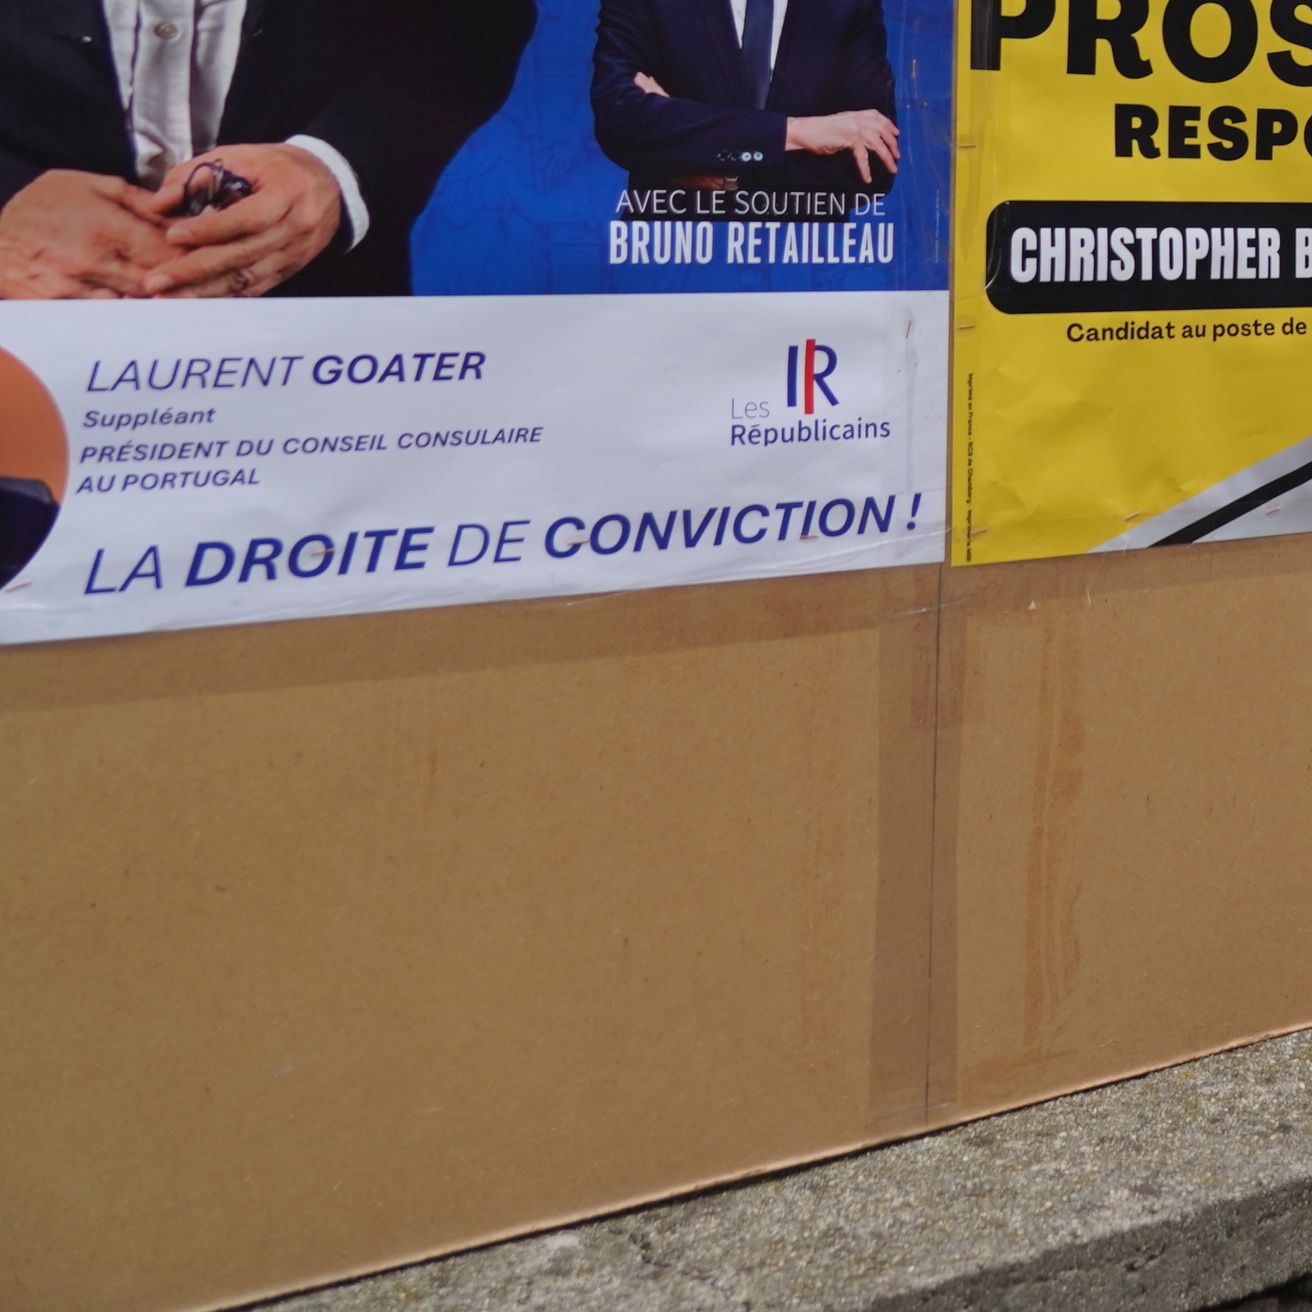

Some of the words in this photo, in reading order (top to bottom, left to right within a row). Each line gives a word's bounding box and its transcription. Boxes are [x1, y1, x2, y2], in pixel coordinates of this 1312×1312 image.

[616, 189, 686, 214] AVEC
[696, 189, 725, 214] LE
[735, 190, 845, 216] SOUTIEN
[855, 192, 886, 216] DE
[609, 220, 713, 265] BRUNO
[727, 221, 894, 265] RETAILLEAU
[1009, 226, 1281, 284] CHRISTOPHER
[1067, 321, 1176, 342] Candidat
[1181, 324, 1206, 338] au
[1212, 318, 1275, 341] poste
[1281, 317, 1307, 335] de
[86, 355, 304, 393] LAURENT
[311, 351, 487, 386] GOATER
[82, 406, 216, 431] Suppléant
[731, 397, 770, 419] Les
[79, 438, 229, 464] PRÉSIDENT
[235, 438, 275, 458] DU
[281, 434, 389, 456] CONSEIL
[397, 426, 544, 450] CONSULAIRE
[730, 418, 890, 447] Républicains
[76, 474, 113, 494] AU
[121, 468, 261, 492] PORTUGAL
[82, 545, 164, 596] LA
[184, 526, 435, 588] DROITE
[448, 519, 531, 566] DE
[543, 494, 899, 560] CONVICTION
